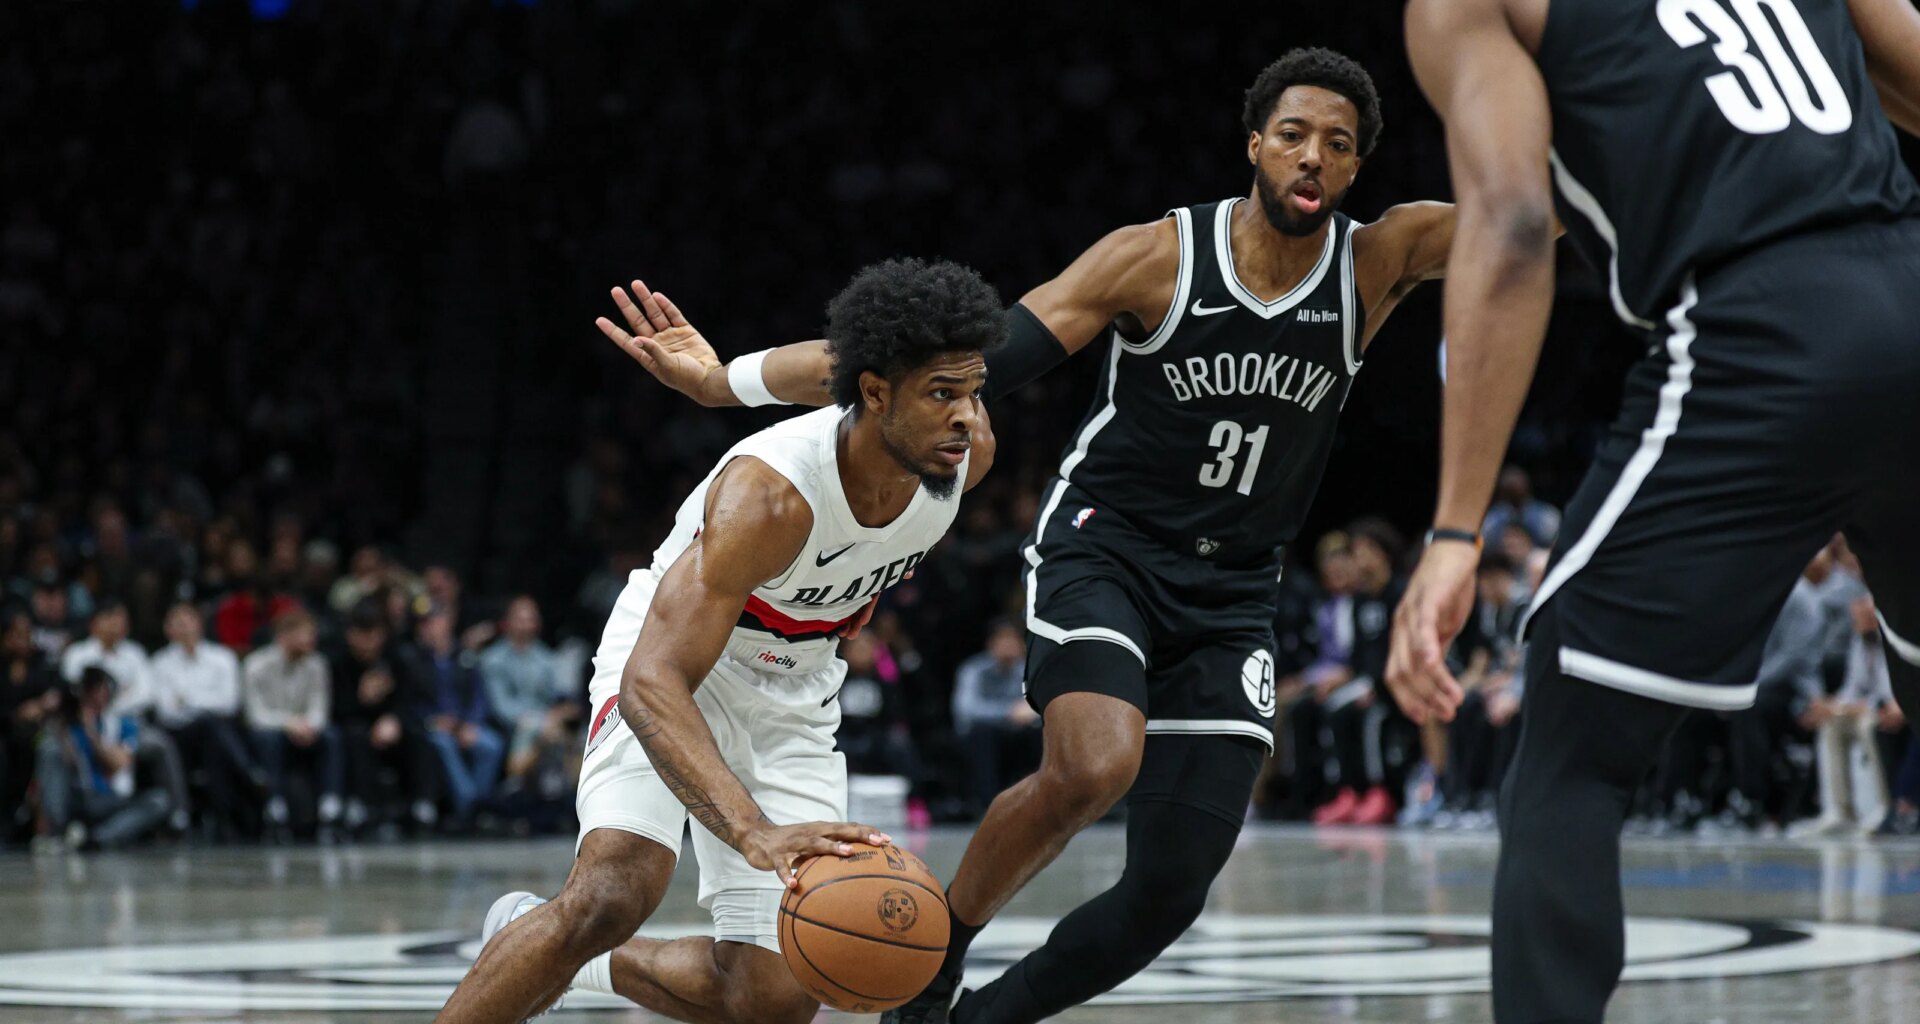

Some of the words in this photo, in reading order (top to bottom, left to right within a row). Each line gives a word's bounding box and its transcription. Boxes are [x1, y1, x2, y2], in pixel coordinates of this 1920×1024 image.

[1656, 0, 1852, 135] 30
[1296, 309, 1310, 322] All
[1311, 309, 1321, 323] In
[1162, 352, 1338, 413] BROOKLYN
[1198, 420, 1270, 496] 31
[784, 546, 936, 606] BLAZER
